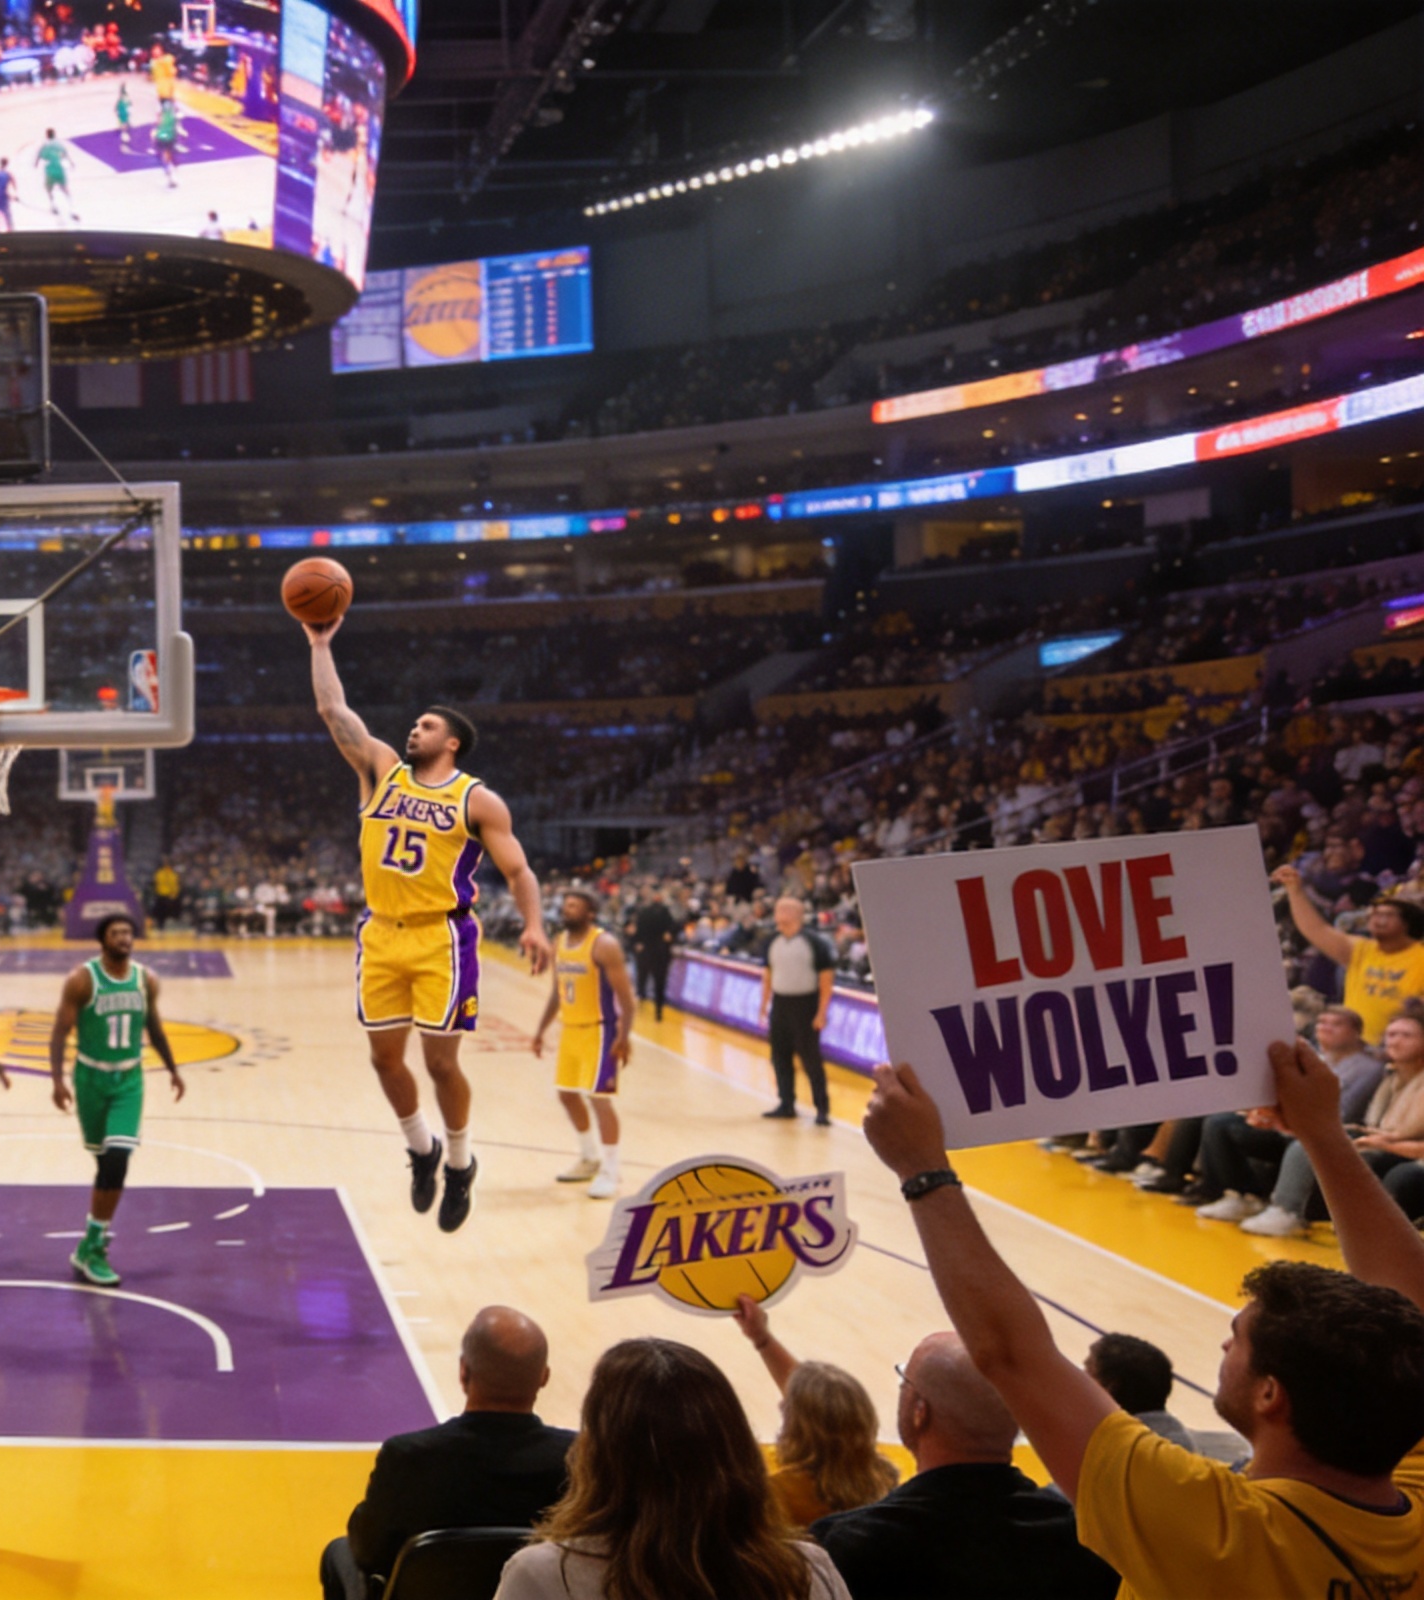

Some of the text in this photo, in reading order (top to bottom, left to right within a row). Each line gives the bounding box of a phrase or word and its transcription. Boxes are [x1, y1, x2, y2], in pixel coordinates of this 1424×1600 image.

[381, 826, 427, 873] 15
[955, 853, 1188, 989] LOVE
[929, 962, 1238, 1115] WOLYE!
[599, 1195, 851, 1292] LAKERS
